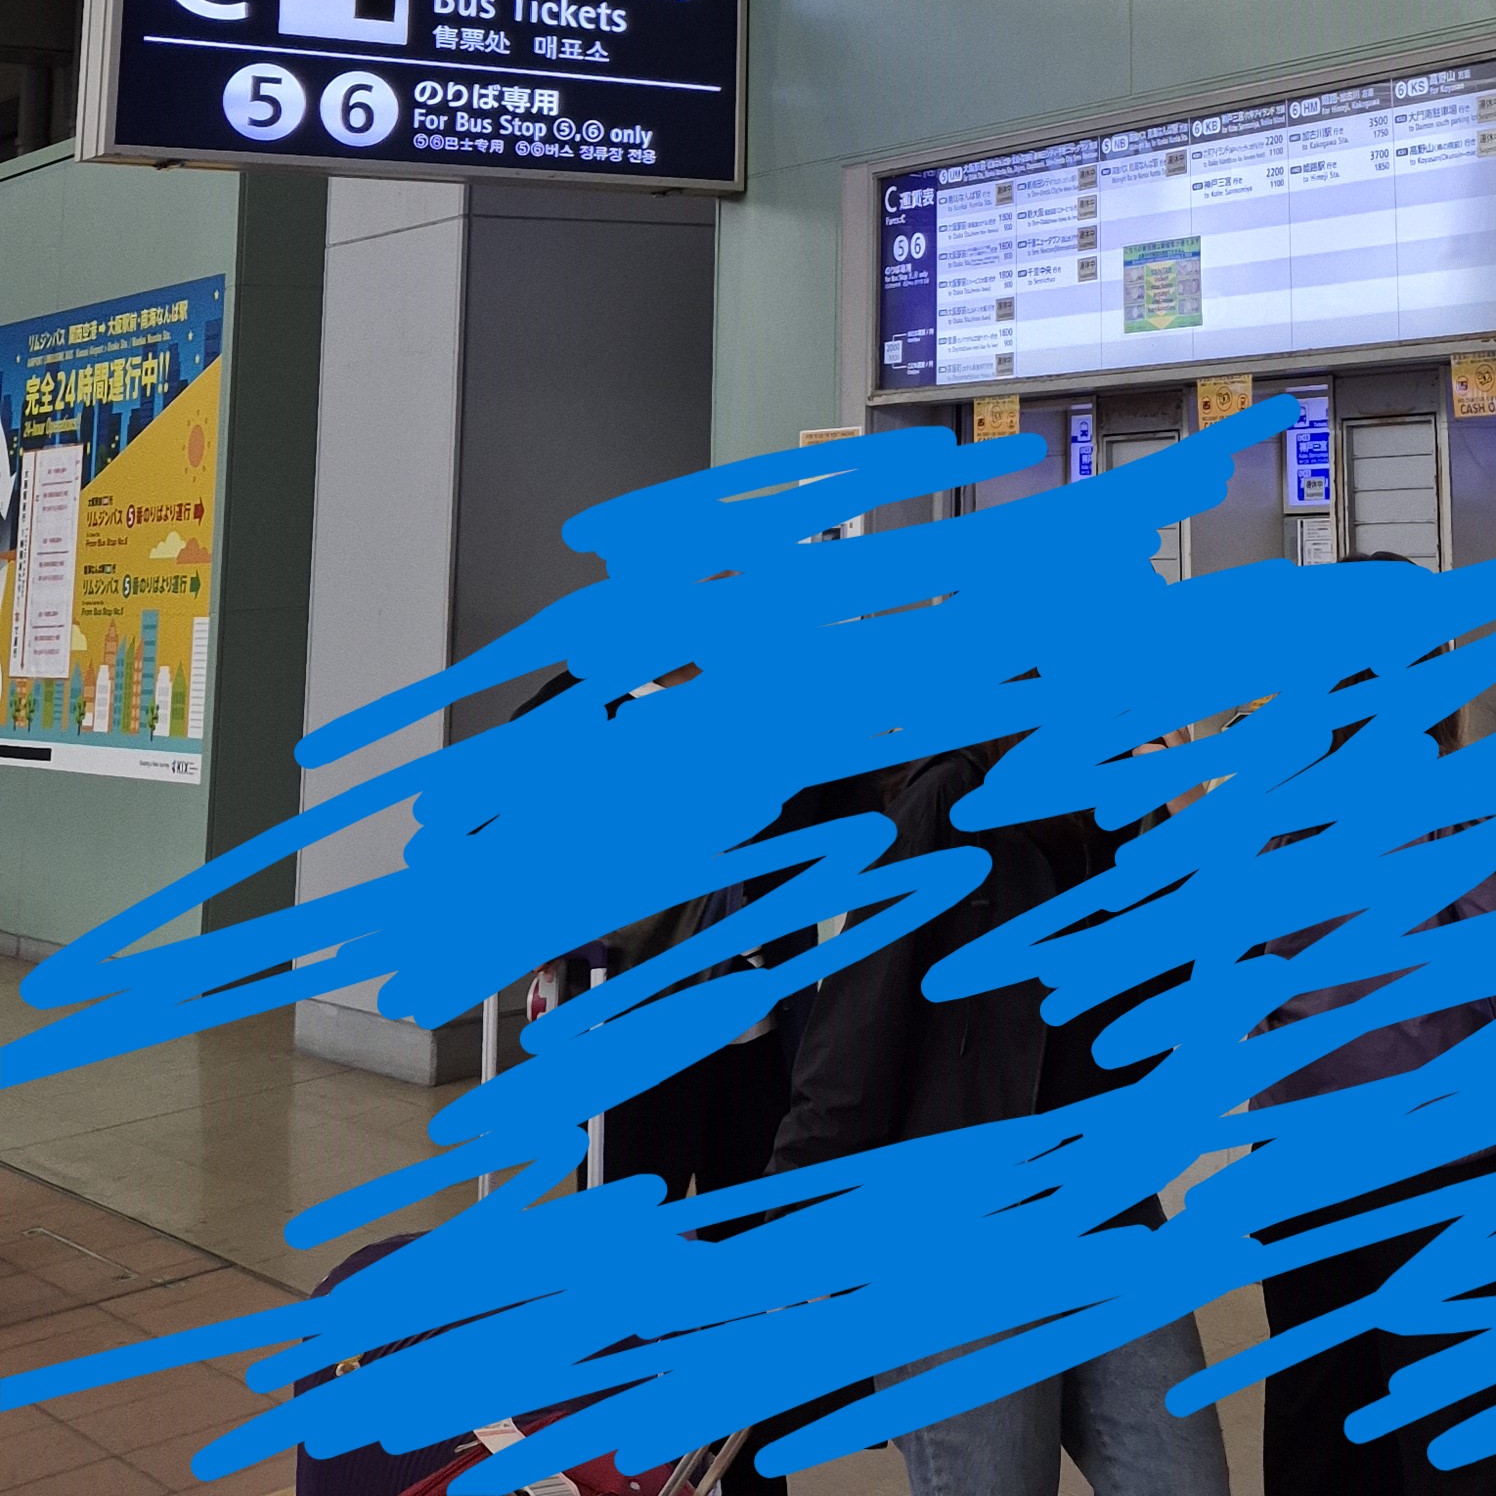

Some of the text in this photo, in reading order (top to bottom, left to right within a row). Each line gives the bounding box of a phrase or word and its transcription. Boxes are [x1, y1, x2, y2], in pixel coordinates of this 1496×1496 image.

[432, 24, 511, 55] 售票处
[533, 35, 610, 63] 매표소
[413, 80, 560, 116] のりば専用
[413, 108, 448, 131] For
[455, 111, 492, 134] Bus
[499, 115, 547, 141] Stop
[609, 124, 653, 149] only
[1369, 115, 1389, 128] 3500
[1265, 135, 1284, 146] 2200
[1373, 128, 1389, 138] 1750
[579, 144, 623, 163] 정류장
[627, 148, 657, 165] 전용
[1269, 147, 1284, 156] 1100
[1370, 148, 1390, 161] 3700
[1266, 166, 1284, 178] 2200
[1374, 162, 1390, 171] 1850
[1270, 179, 1285, 188] 1100
[884, 185, 898, 213] C
[28, 328, 66, 352] リムジンバス
[24, 351, 171, 416] 完全24時間運行中!!
[1460, 403, 1486, 415] CASH
[86, 508, 123, 527] リムジンバス
[82, 577, 119, 596] リムジンバス
